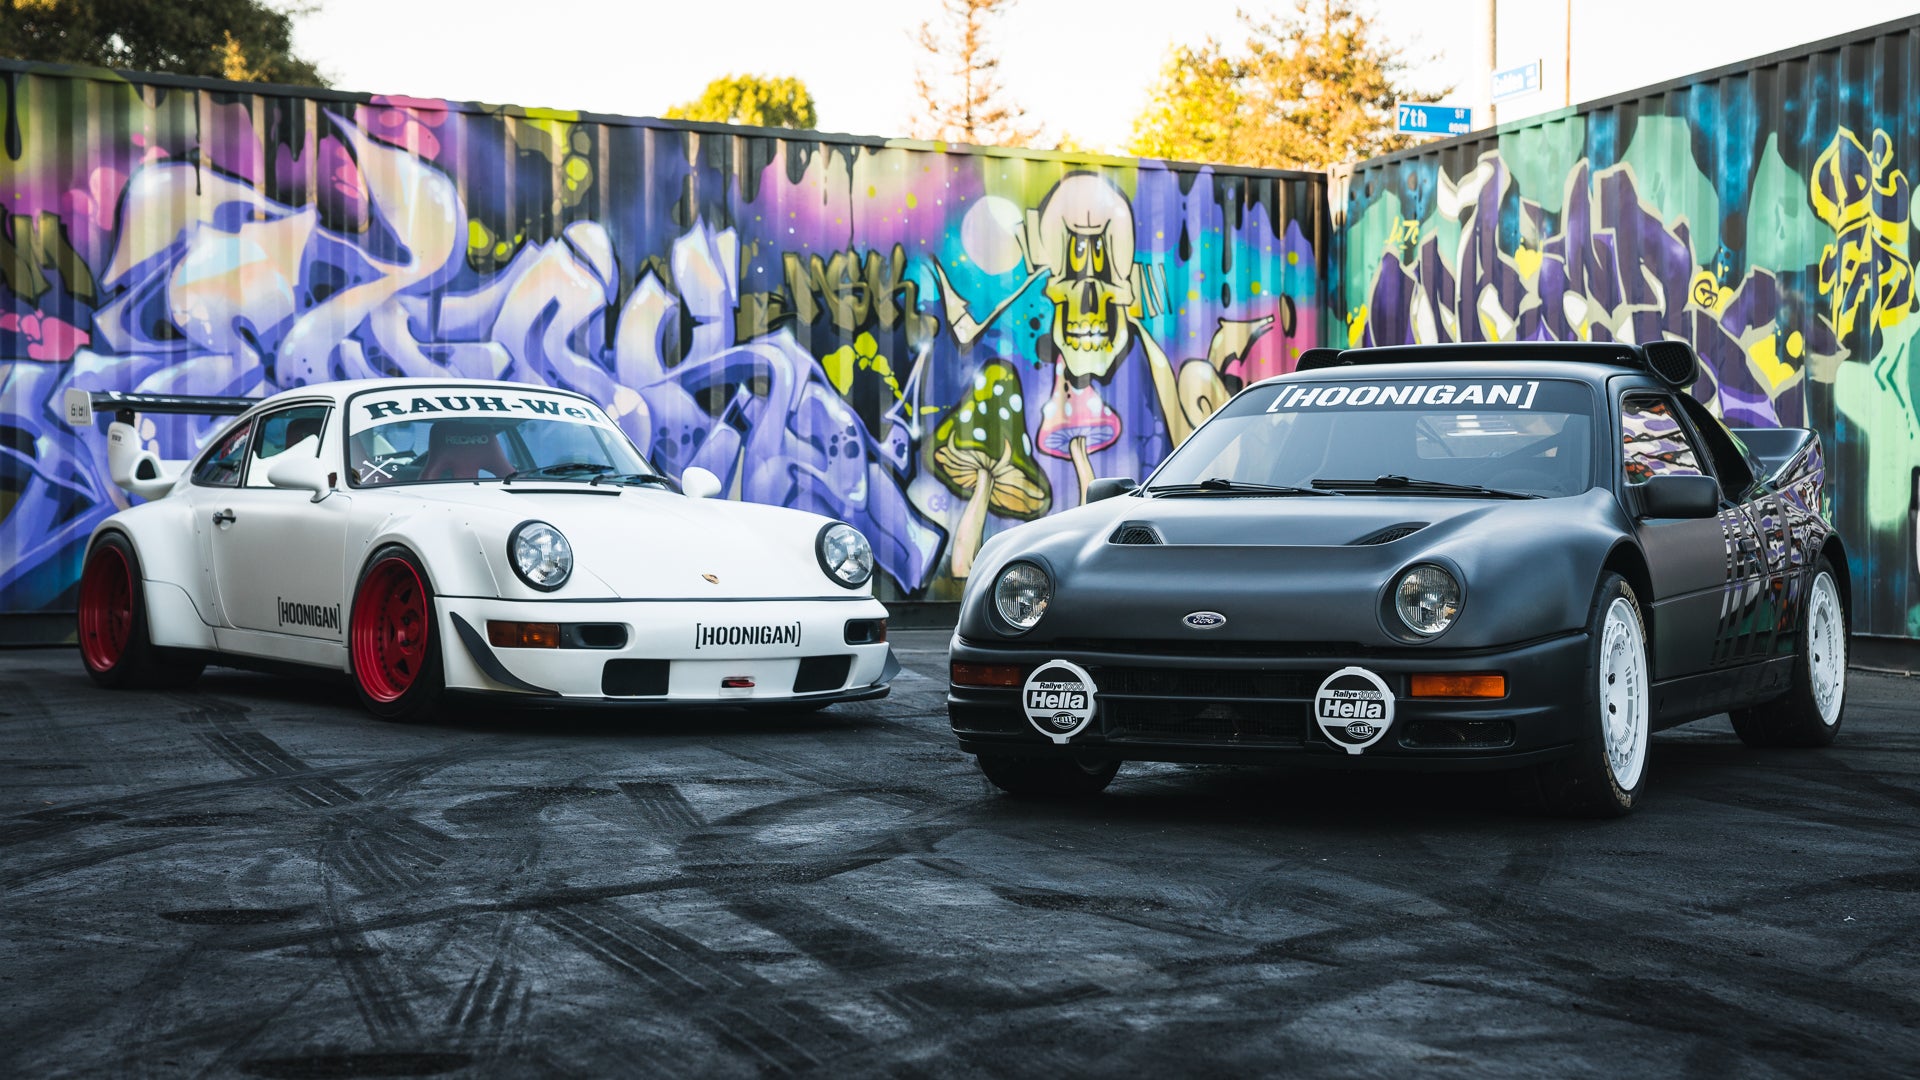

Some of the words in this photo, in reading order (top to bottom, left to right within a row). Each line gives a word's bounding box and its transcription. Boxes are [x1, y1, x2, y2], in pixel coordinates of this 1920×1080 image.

[1400, 107, 1427, 128] 7th
[1455, 109, 1465, 120] ST
[1266, 381, 1540, 413] [HOONIGAN]
[362, 396, 599, 423] RAUH-Wel
[277, 596, 342, 634] [HOONIGAN]
[1192, 614, 1215, 624] Ford
[695, 621, 801, 649] [HOONIGAN]
[1040, 682, 1061, 691] Rallye
[1333, 690, 1357, 699] Rallye
[1030, 691, 1084, 709] Hella
[1323, 700, 1382, 718] Hella
[1053, 716, 1077, 724] HELLA
[1347, 725, 1374, 734] HELLA
